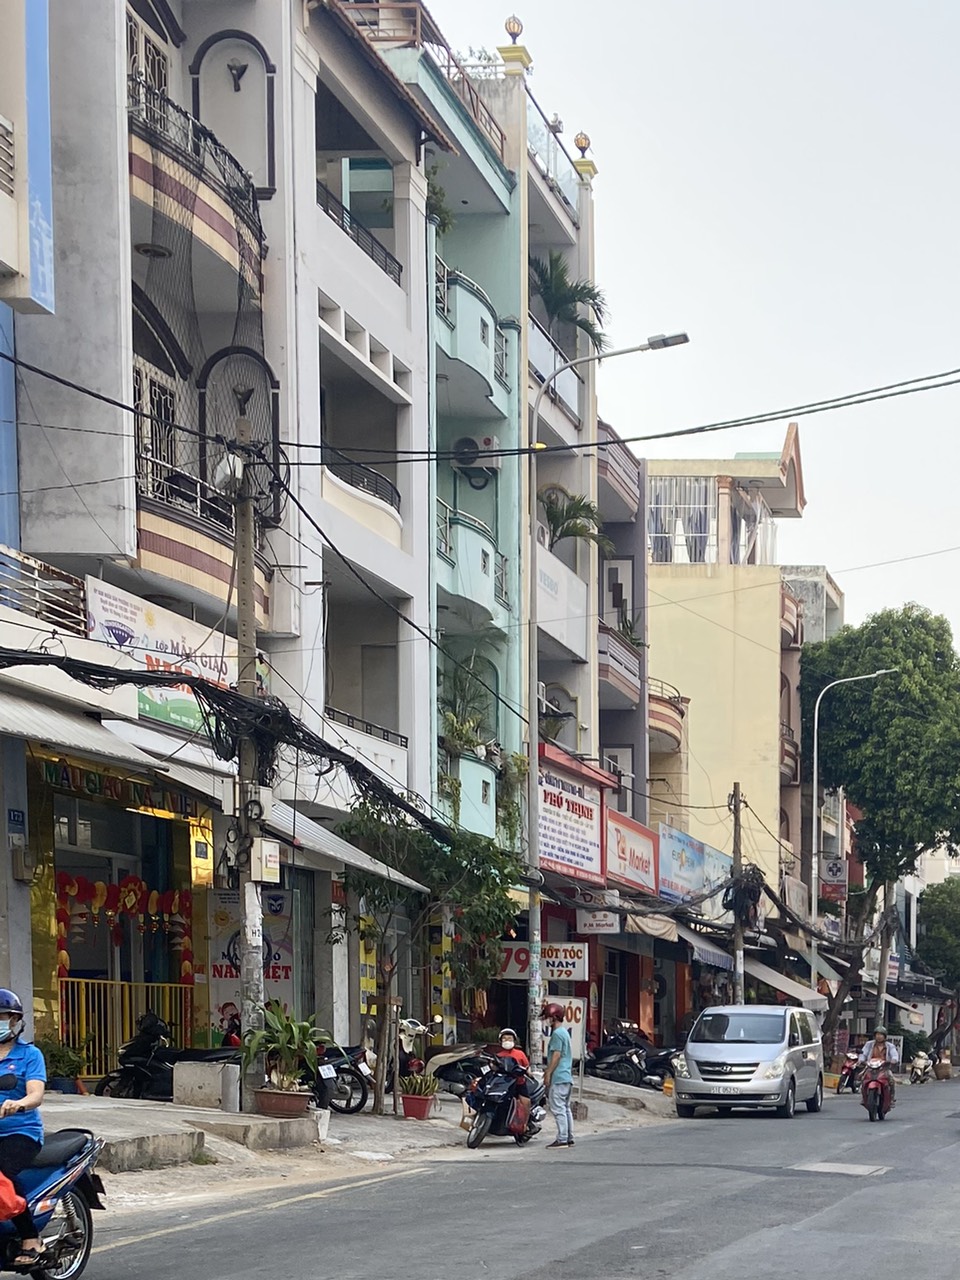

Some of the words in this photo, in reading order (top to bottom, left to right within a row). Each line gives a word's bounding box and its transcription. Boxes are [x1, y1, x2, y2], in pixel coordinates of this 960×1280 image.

[629, 847, 651, 875] Market
[562, 945, 583, 960] TÓC
[546, 960, 576, 968] NAM
[549, 969, 573, 978] 179
